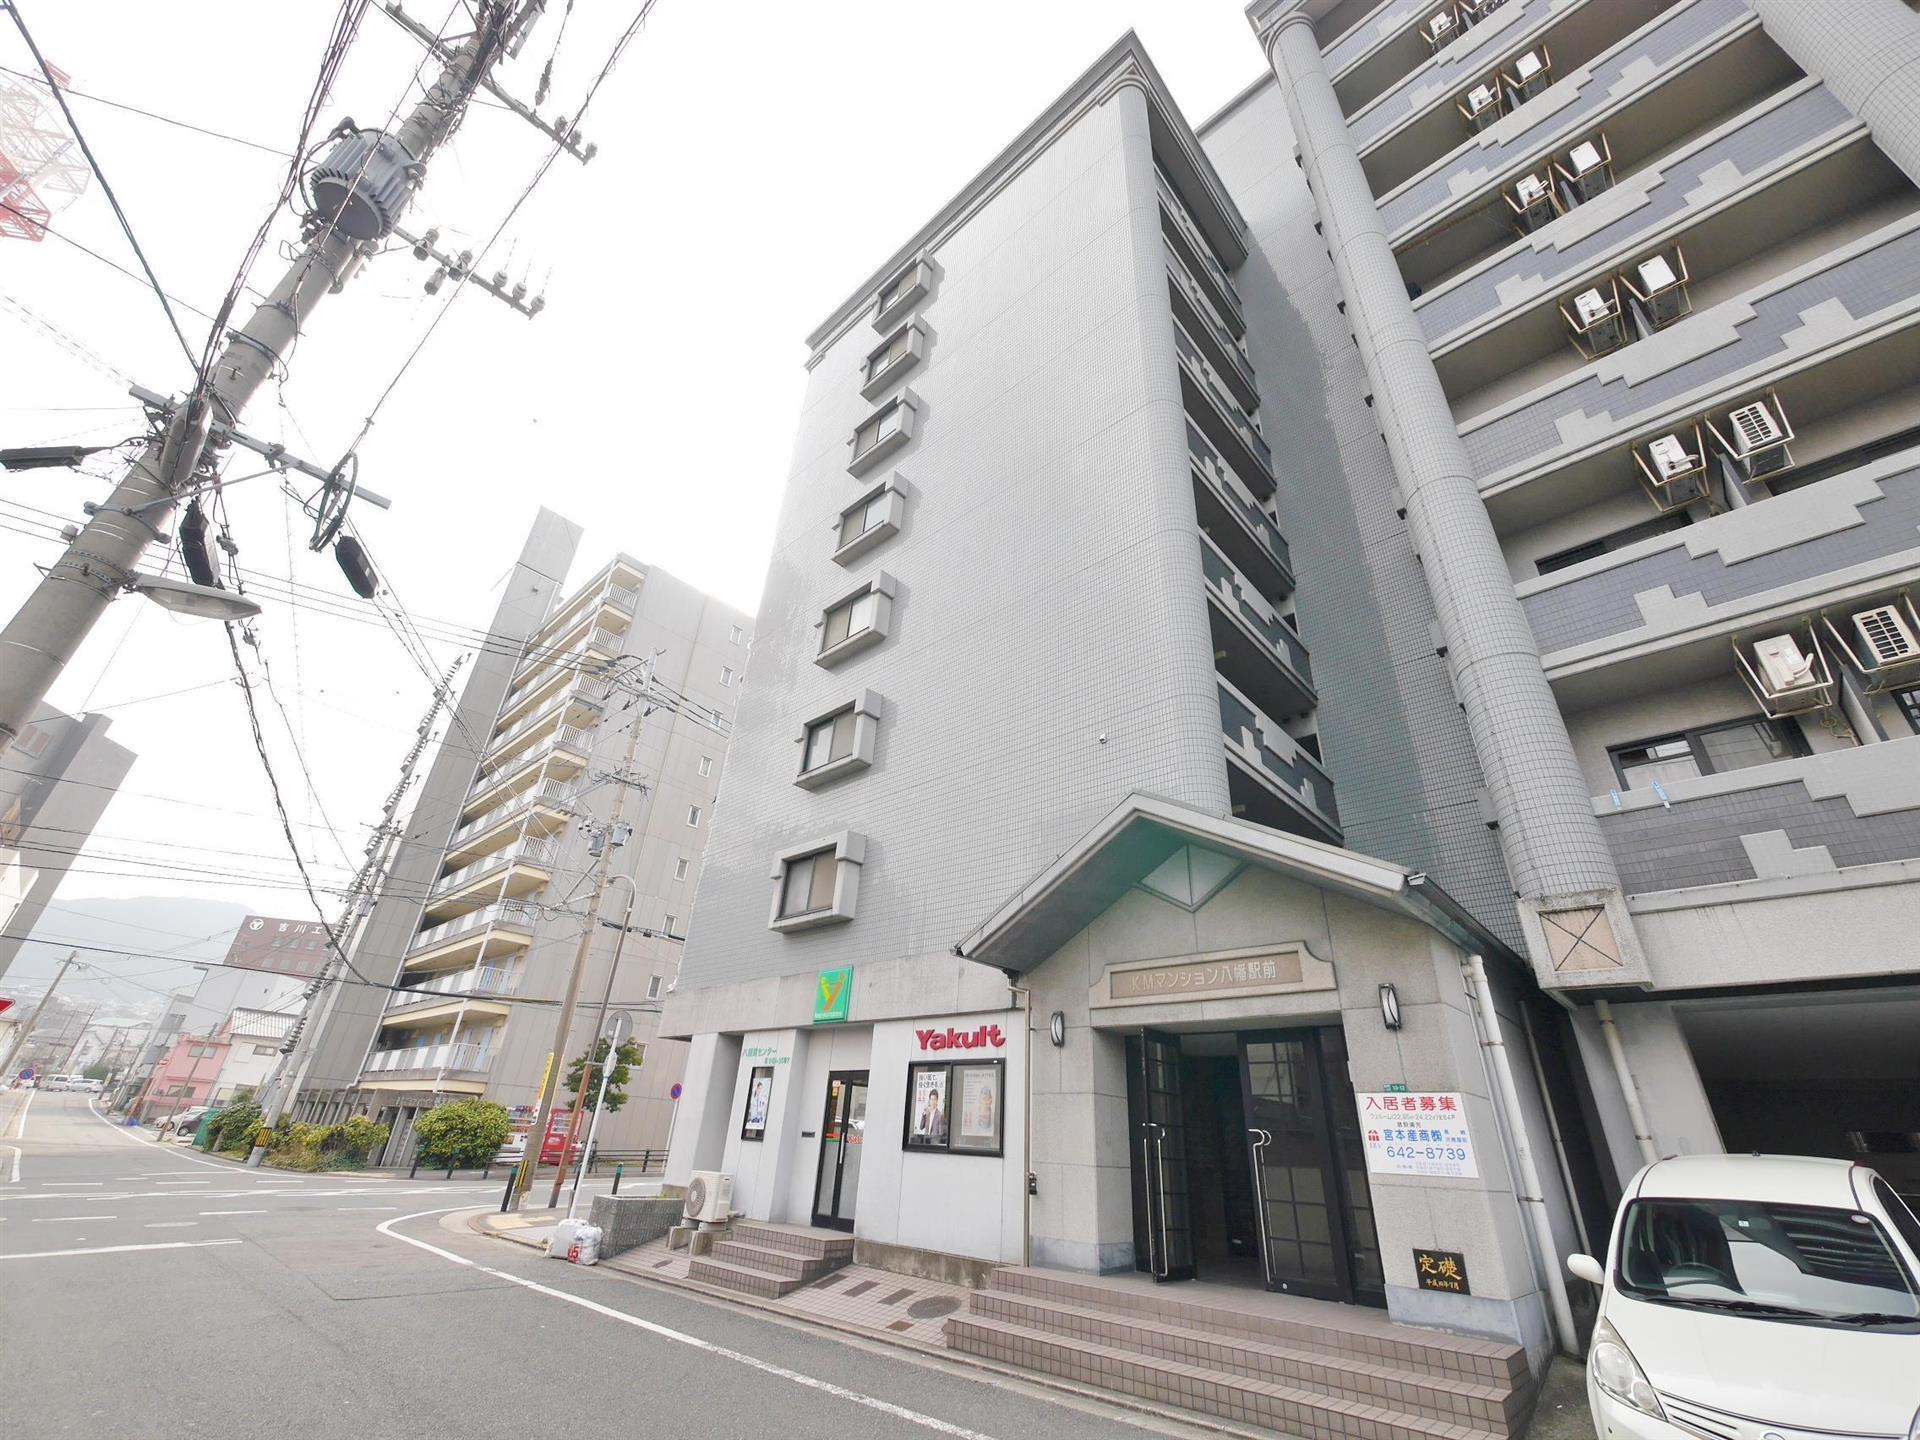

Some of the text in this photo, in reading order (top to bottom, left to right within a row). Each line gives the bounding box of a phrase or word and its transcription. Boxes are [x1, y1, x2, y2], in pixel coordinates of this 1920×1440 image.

[916, 1024, 1006, 1050] Yakult
[1366, 1096, 1457, 1112] 入居者募集
[1386, 1146, 1466, 1161] 642-8739
[1419, 1254, 1462, 1280] 定礎
